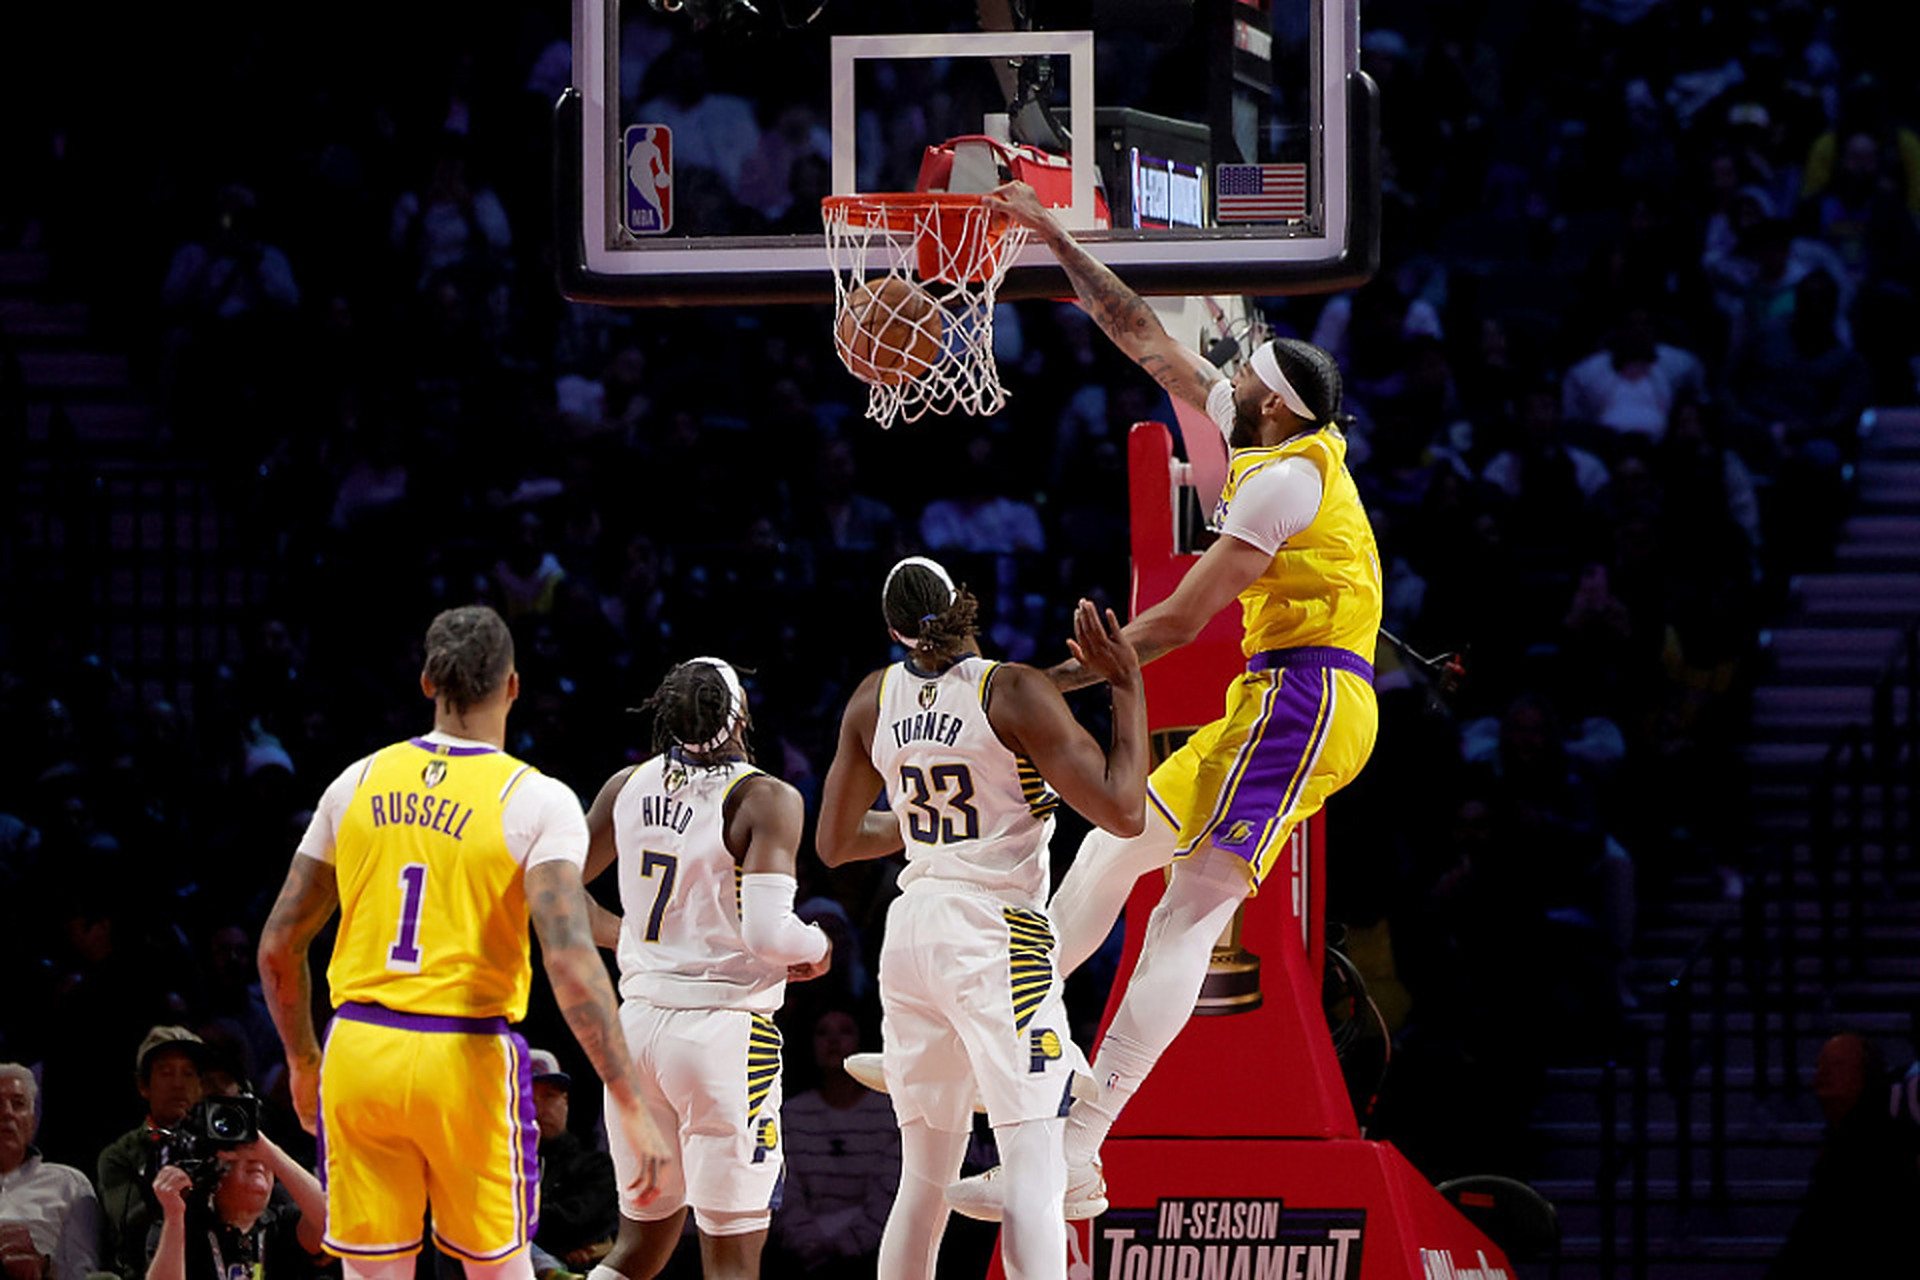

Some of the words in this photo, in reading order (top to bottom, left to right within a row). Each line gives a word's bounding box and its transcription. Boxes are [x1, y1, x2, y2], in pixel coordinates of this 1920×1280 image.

[632, 208, 655, 228] NBA
[892, 711, 963, 748] TURNER
[371, 791, 473, 841] RUSSELL
[642, 795, 694, 835] HIELD
[900, 763, 980, 846] 33
[385, 862, 428, 974] 1
[640, 849, 678, 943] 7
[1157, 1201, 1280, 1240] IN-SEASON
[1103, 1229, 1361, 1280] TOURNAMENT
